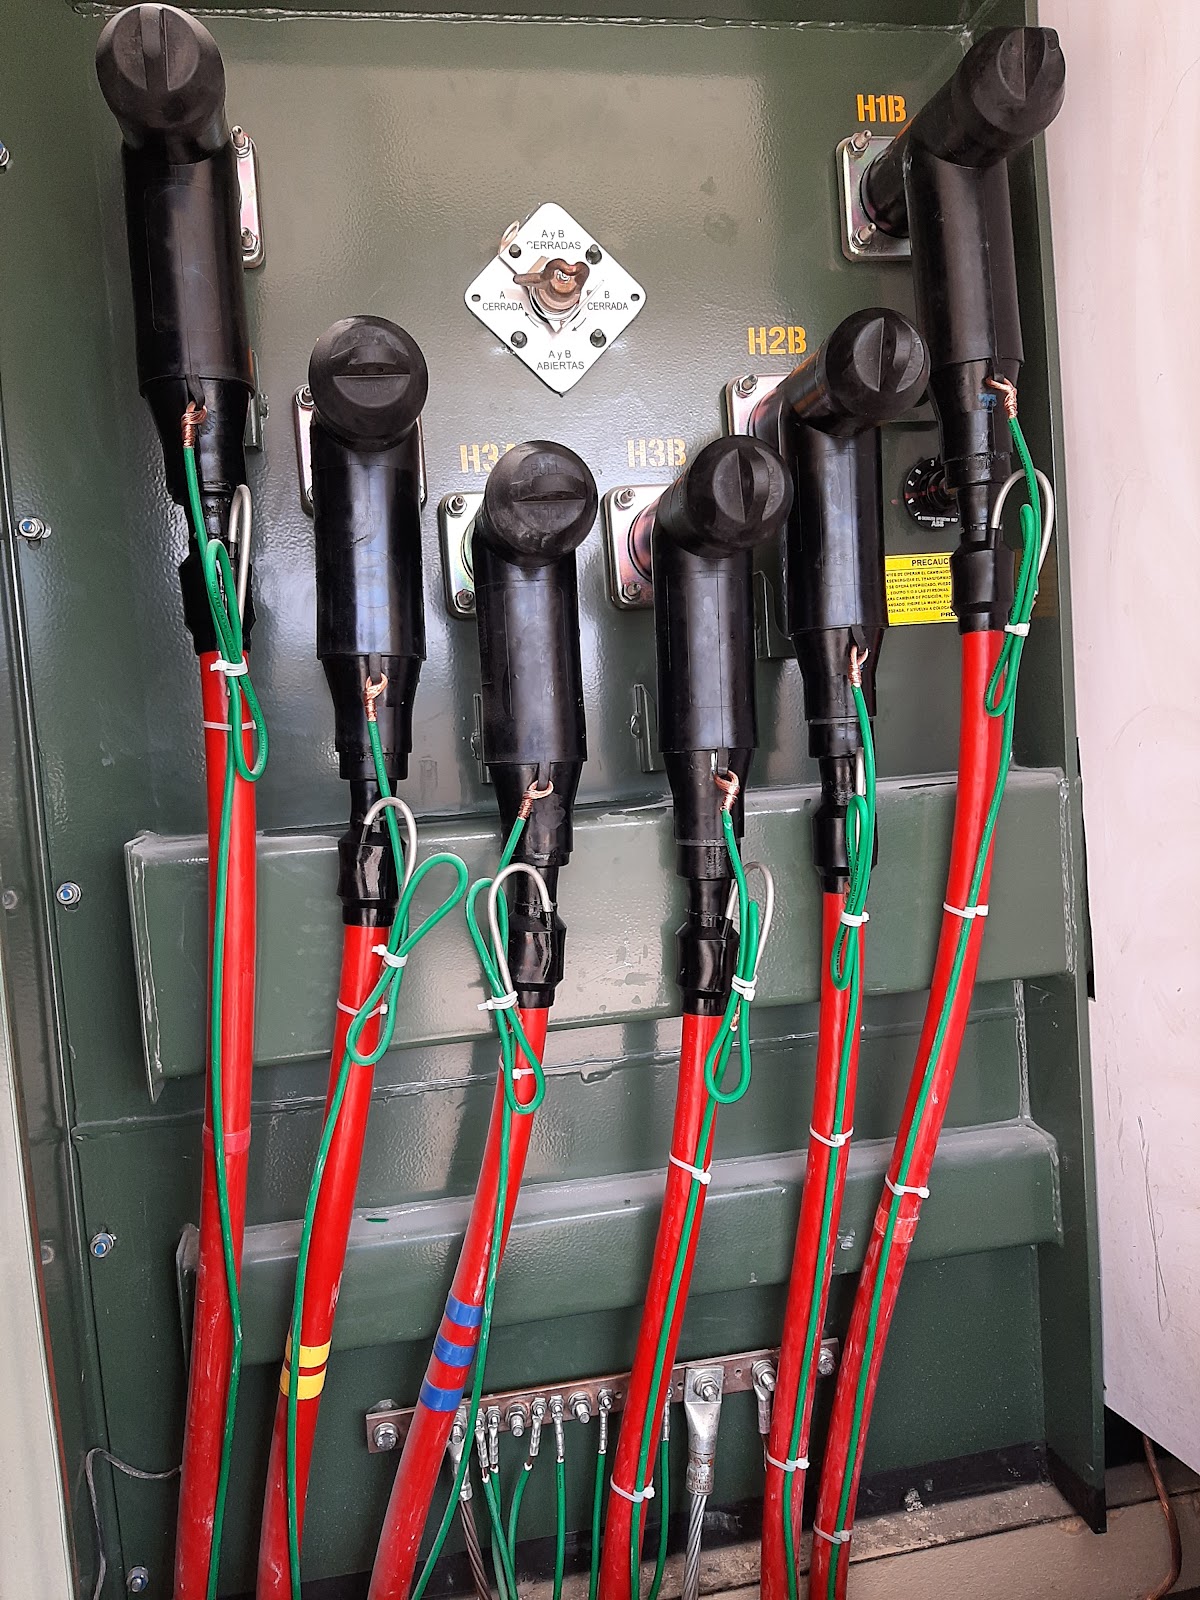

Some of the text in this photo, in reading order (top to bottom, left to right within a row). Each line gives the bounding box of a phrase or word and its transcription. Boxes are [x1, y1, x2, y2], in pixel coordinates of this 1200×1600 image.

[856, 94, 906, 122] H1B
[542, 230, 548, 238] A
[550, 231, 555, 240] y
[526, 241, 581, 250] CERRADAS
[500, 291, 505, 299] A
[483, 302, 524, 311] CERRADA
[587, 302, 628, 311] CERRADA
[748, 326, 806, 355] H2B
[537, 361, 585, 370] ABIERTAS
[626, 438, 686, 468] H3B
[460, 443, 516, 473] H3
